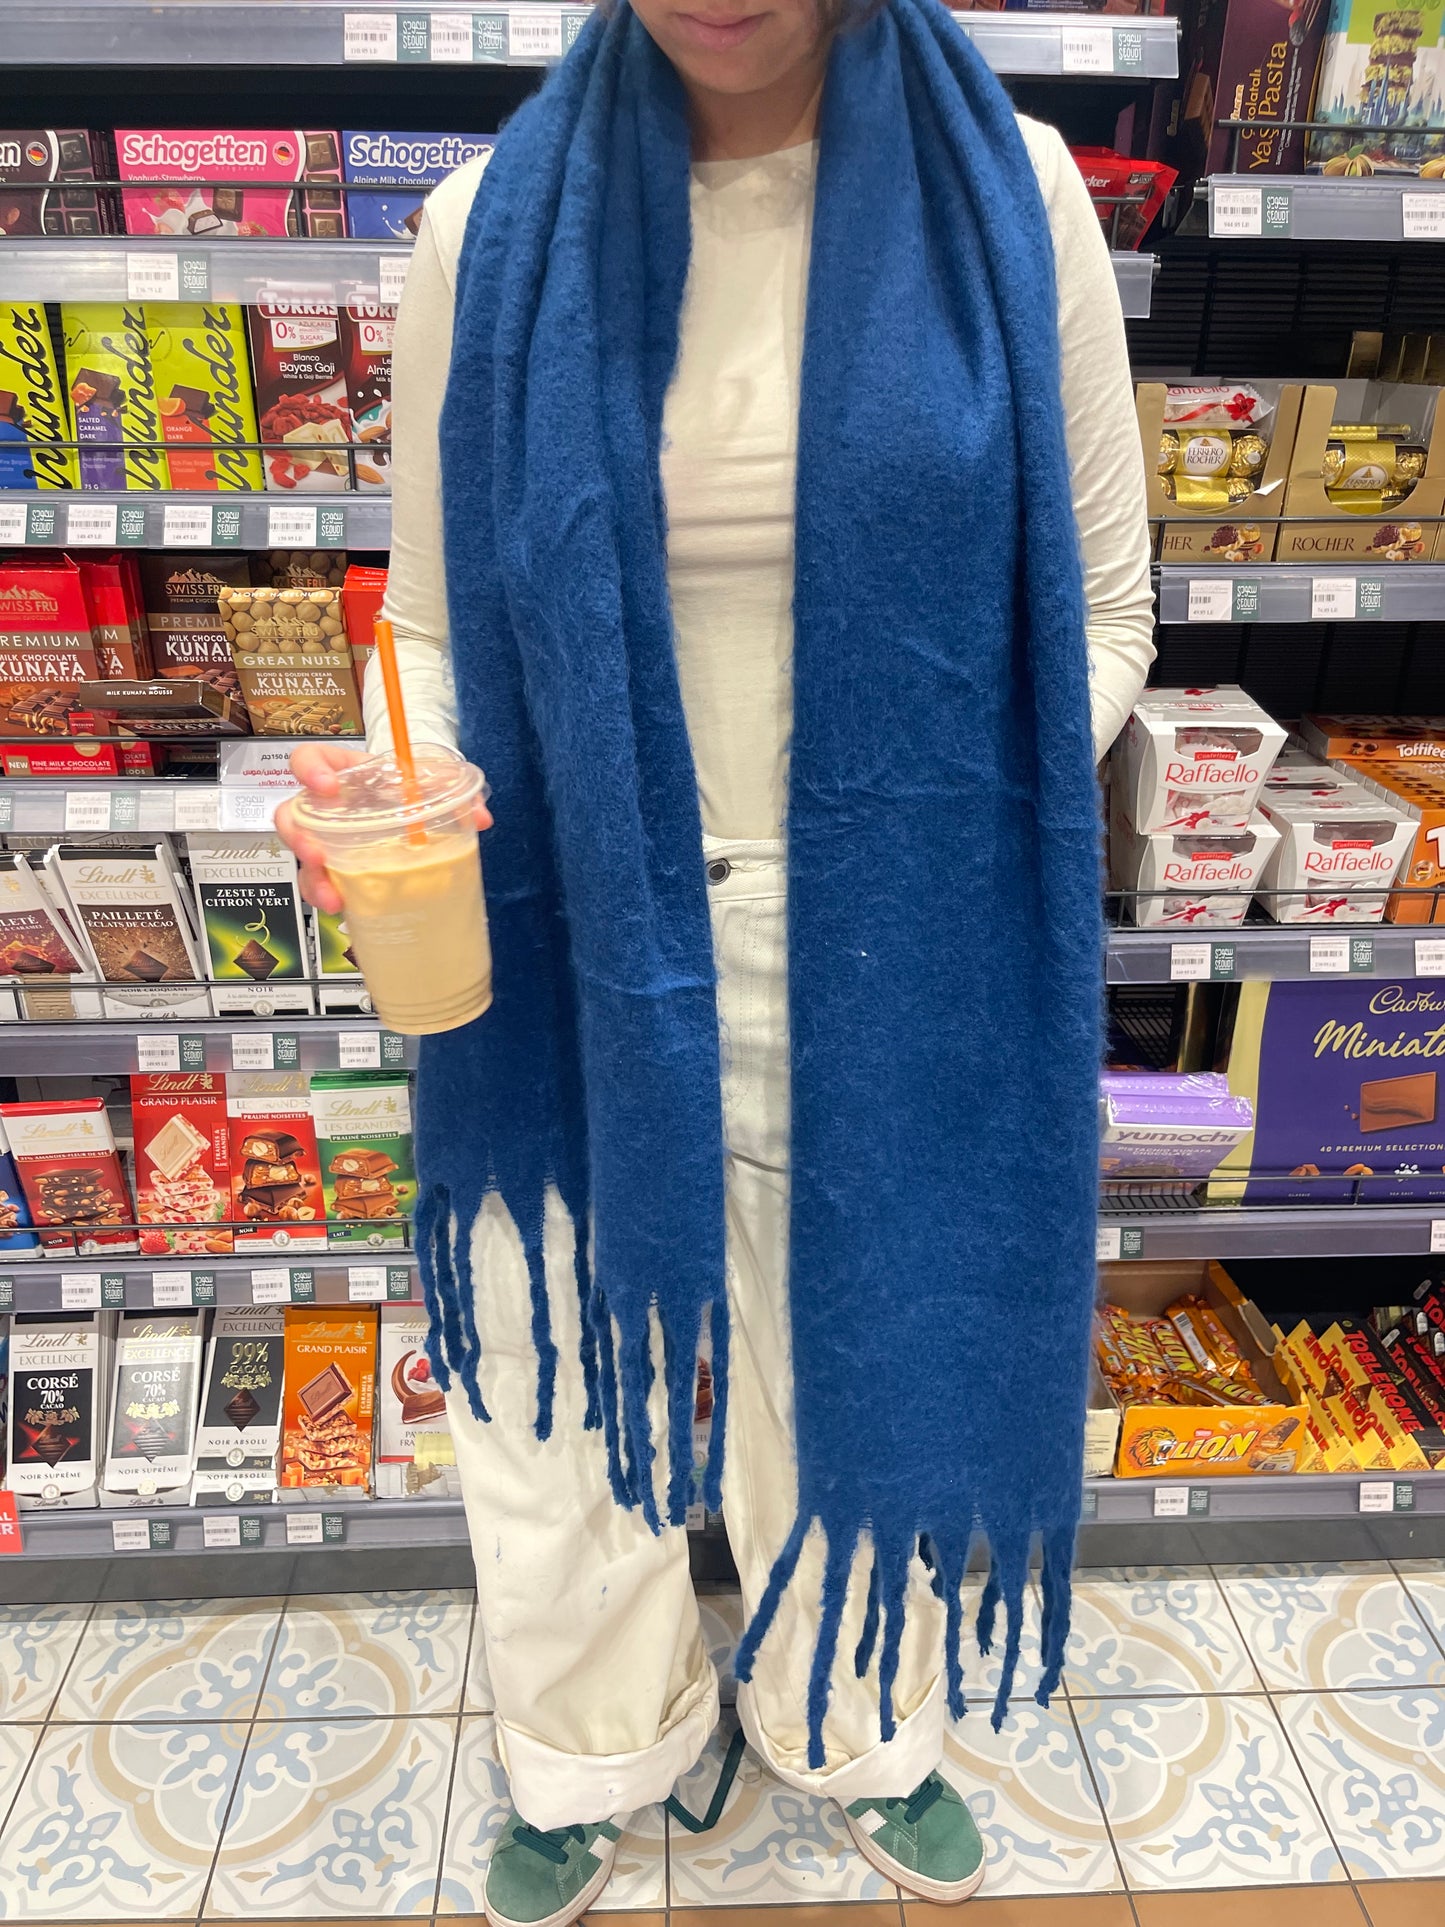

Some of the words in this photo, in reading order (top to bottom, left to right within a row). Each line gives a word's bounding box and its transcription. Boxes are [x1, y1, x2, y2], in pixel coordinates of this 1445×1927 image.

[1258, 41, 1288, 116] Pasta
[123, 134, 267, 171] Schogetten
[353, 176, 377, 184] Alpine
[398, 176, 437, 185] Chocolate
[262, 292, 337, 316] TORRAS
[276, 322, 296, 339] 0%
[364, 325, 384, 342] 0%
[293, 354, 320, 362] Blanco
[279, 362, 312, 374] Bayas
[315, 362, 336, 374] Goji
[102, 307, 161, 490] wunder
[183, 307, 252, 490] wunder
[1188, 447, 1223, 455] FERRERO
[1187, 456, 1221, 464] ROCHER
[1292, 537, 1355, 551] ROCHER
[165, 584, 203, 595] SWISS
[0, 601, 33, 612] WISS
[36, 601, 58, 612] FRU
[251, 626, 293, 636] SWISS
[297, 626, 319, 636] FRU
[0, 635, 80, 647] REMIUM
[243, 656, 296, 666] GREAT
[302, 655, 341, 665] NUTS
[258, 678, 338, 688] KUNAFA
[251, 688, 287, 696] WHOLE
[289, 688, 346, 696] HAZELNUTS
[9, 761, 28, 769] NEW
[1165, 763, 1259, 785] Raffaello
[202, 840, 264, 859] Lindt
[1304, 852, 1393, 873] Raffaello
[76, 866, 138, 884] Lindt
[204, 867, 284, 879] EXCELLENCE
[1163, 863, 1252, 883] Raffaello
[80, 890, 162, 900] EXCELLENCE
[217, 889, 256, 897] ZESTE
[260, 889, 276, 897] DE
[205, 898, 253, 907] CITRON
[257, 897, 290, 906] VERT
[92, 909, 163, 920] PAILLETÉ
[141, 920, 174, 928] CACAO
[1369, 985, 1445, 1015] Cadbu
[1313, 1020, 1445, 1059] Miniat
[145, 1073, 200, 1091] Lindt
[140, 1098, 178, 1106] GRAND
[181, 1097, 217, 1105] PLAISIR
[325, 1100, 383, 1116] Lindt
[1116, 1131, 1236, 1142] yumochi
[223, 1322, 285, 1332] EXCELLENCE
[302, 1322, 352, 1338] Lindt
[126, 1325, 179, 1342] Lindt
[20, 1333, 73, 1347] Lindt
[125, 1348, 191, 1360] EXCELLENCE
[230, 1342, 269, 1364] 99%
[297, 1345, 332, 1354] GRAND
[334, 1345, 367, 1354] PLAISIR
[19, 1354, 87, 1365] EXCELLENCE
[131, 1367, 180, 1383] CORSÉ
[230, 1365, 268, 1373] CACAO
[27, 1373, 78, 1389] CORSÉ
[1343, 1330, 1425, 1434] TOBLERONE
[40, 1389, 64, 1403] 70%
[143, 1384, 166, 1396] 70%
[44, 1471, 81, 1479] SUPRÊME
[141, 1465, 178, 1474] SUPRÊME
